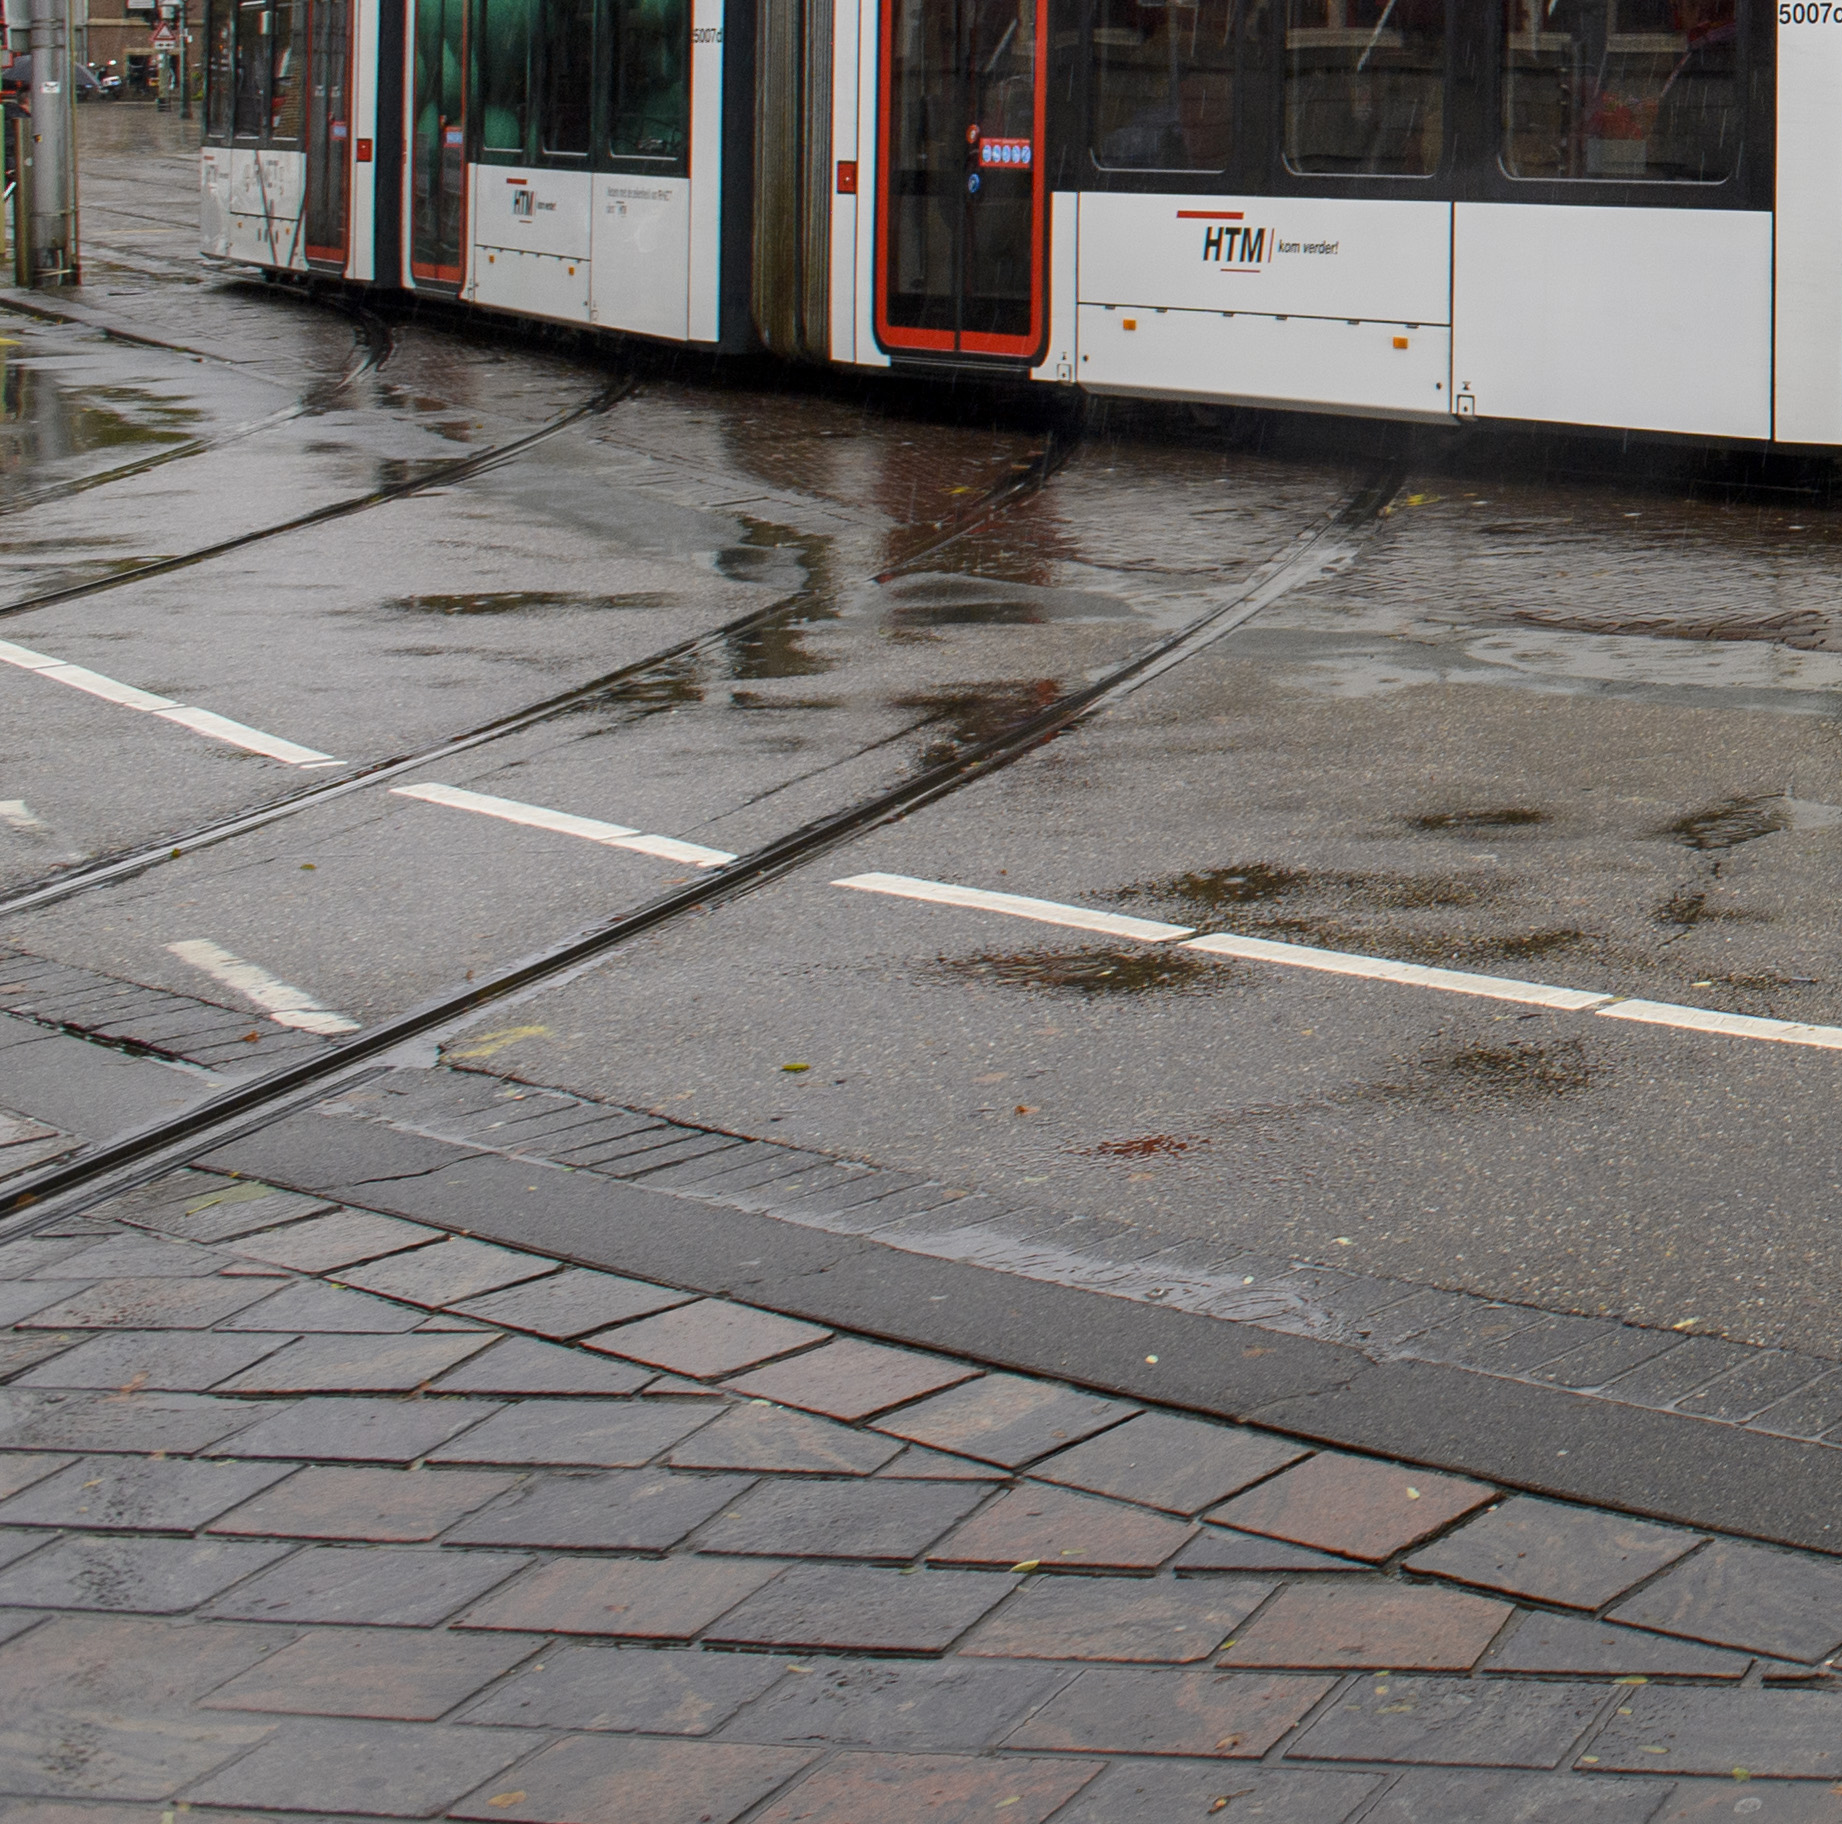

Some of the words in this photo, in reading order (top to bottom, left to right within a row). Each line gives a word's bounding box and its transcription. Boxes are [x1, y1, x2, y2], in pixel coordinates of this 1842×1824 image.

[1203, 226, 1265, 263] HTM
[1278, 239, 1300, 254] kom
[1303, 240, 1339, 255] verder!
